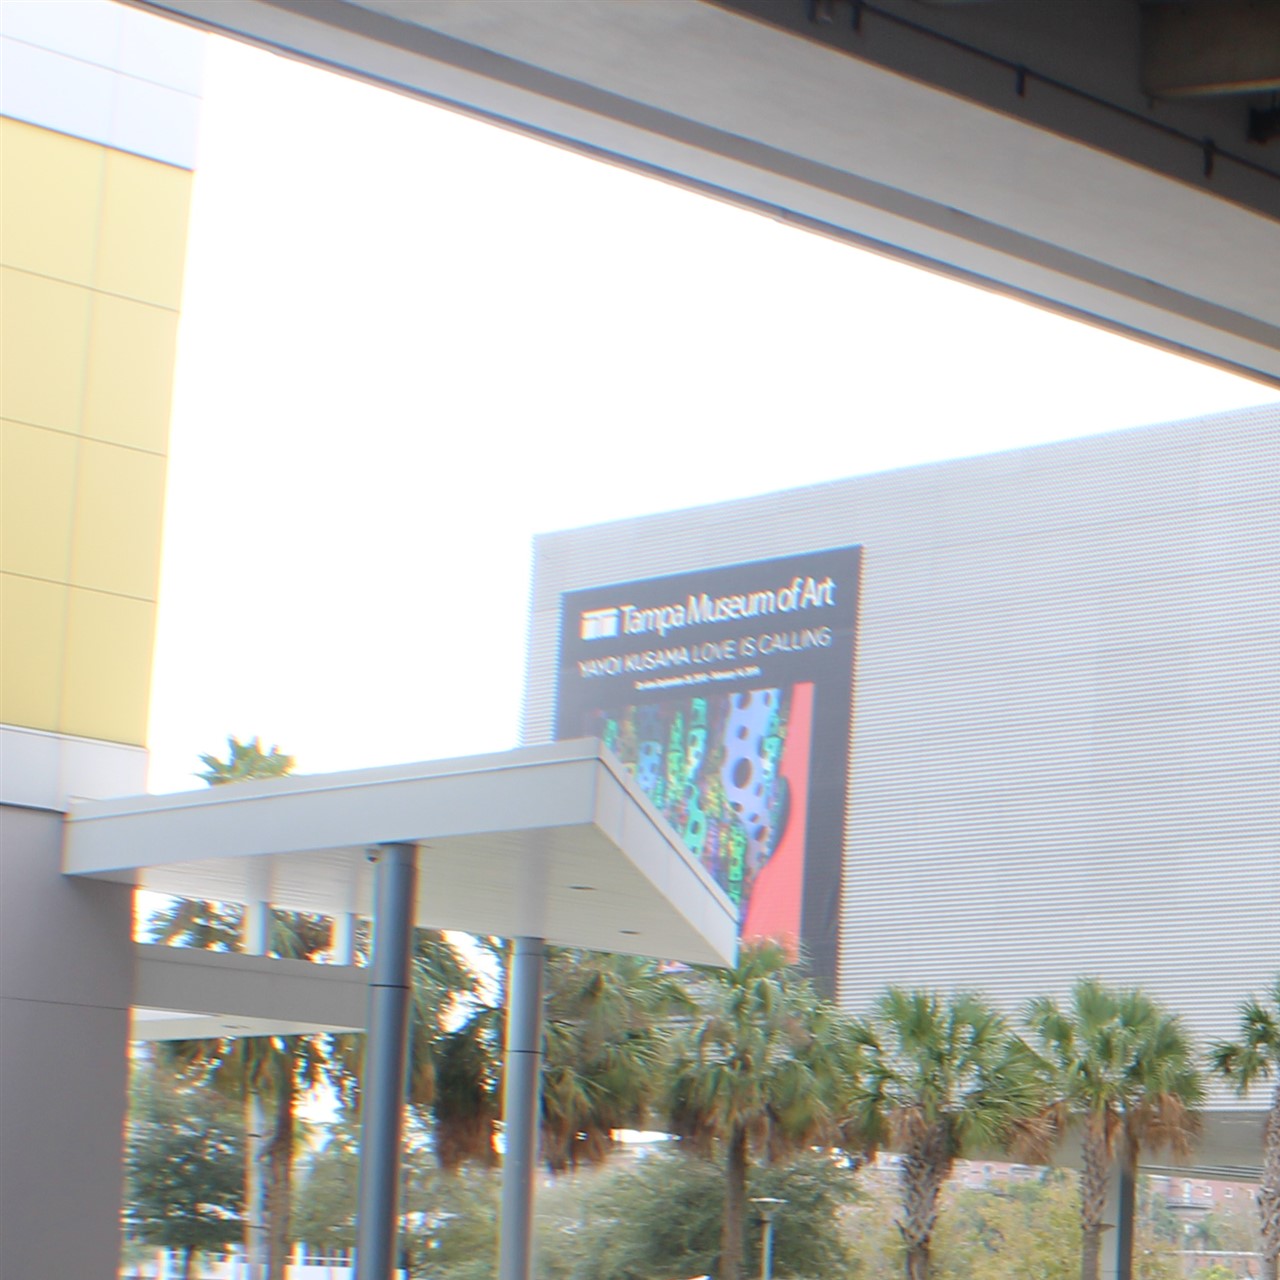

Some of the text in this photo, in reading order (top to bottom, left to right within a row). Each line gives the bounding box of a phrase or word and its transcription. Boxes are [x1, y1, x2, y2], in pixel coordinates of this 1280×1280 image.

[620, 576, 836, 637] Tampa Museum of Art
[577, 656, 623, 679] YAYOI
[623, 645, 691, 674] KUSAMA
[692, 639, 738, 664] LOVE
[739, 635, 758, 658] IS
[757, 625, 833, 656] CALLING
